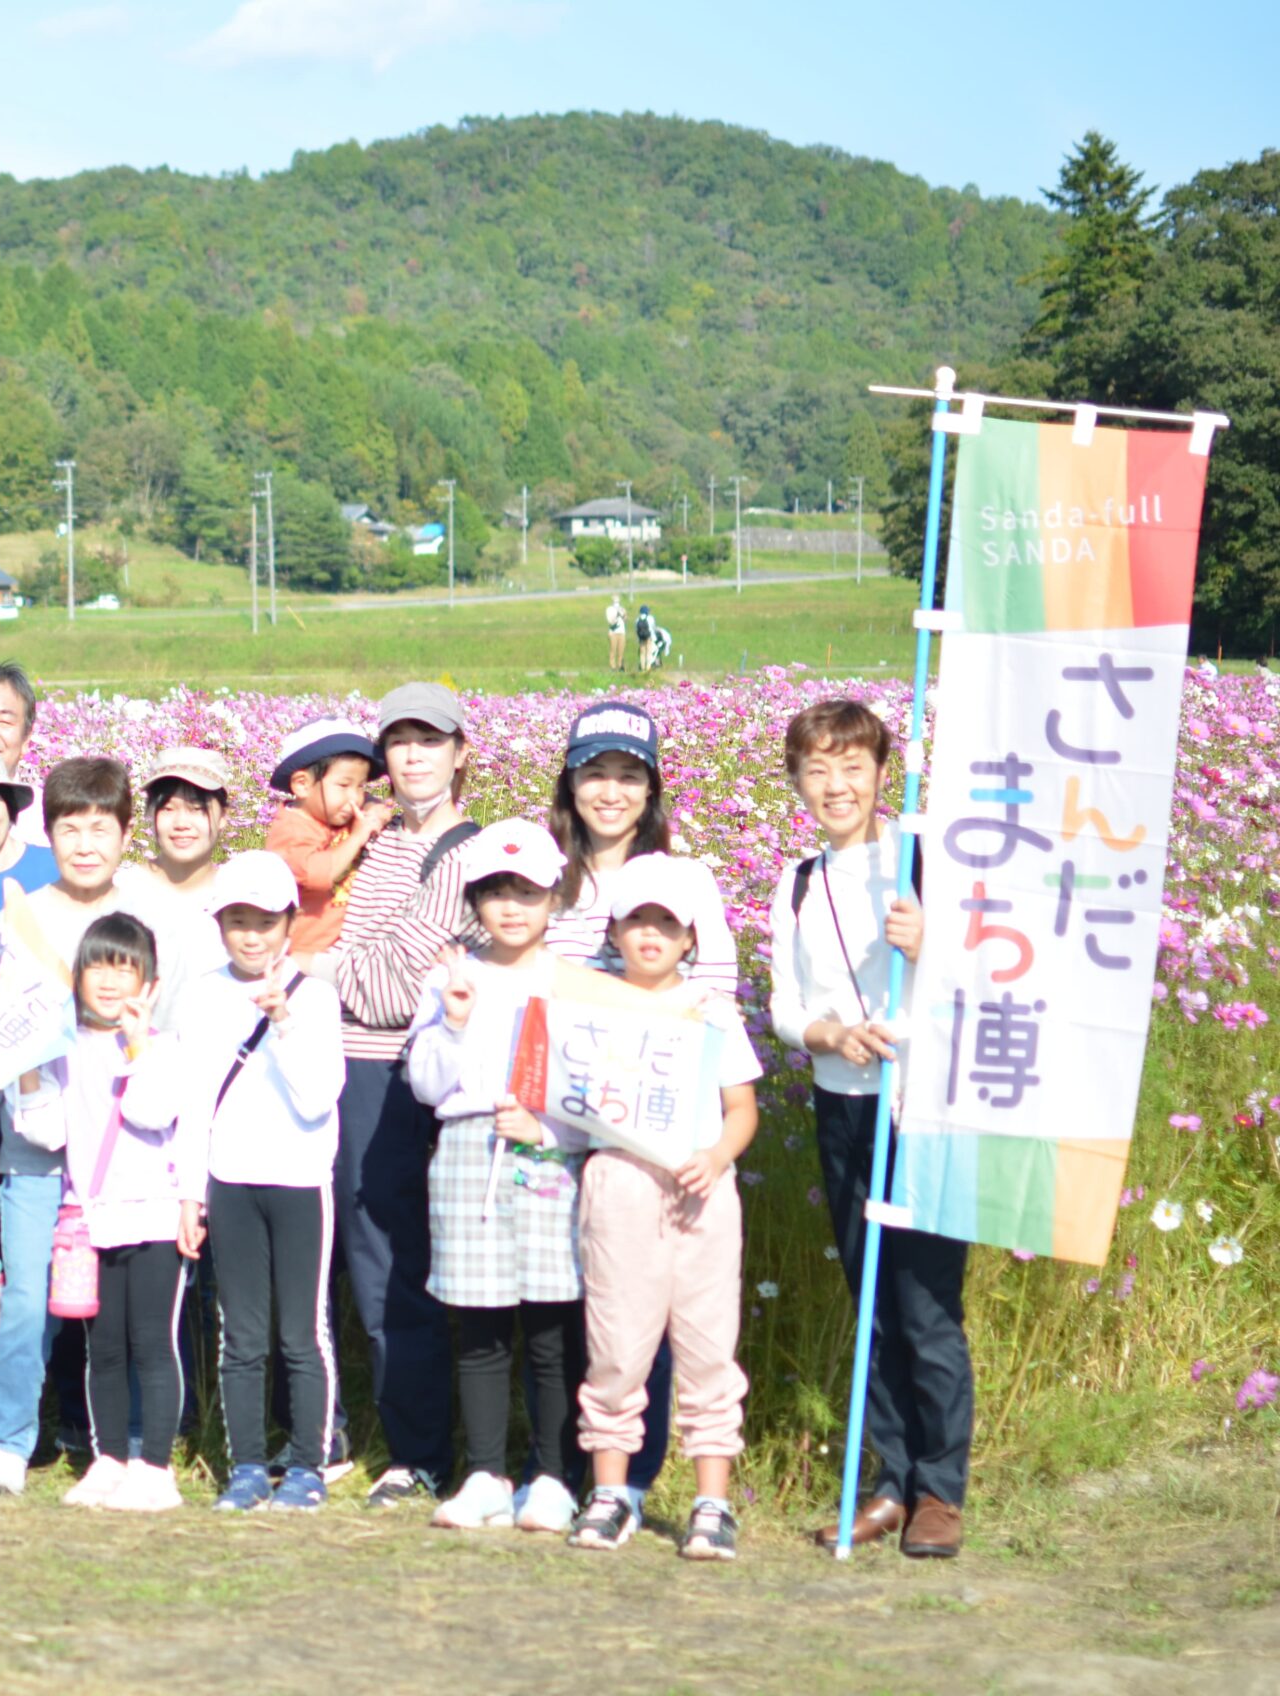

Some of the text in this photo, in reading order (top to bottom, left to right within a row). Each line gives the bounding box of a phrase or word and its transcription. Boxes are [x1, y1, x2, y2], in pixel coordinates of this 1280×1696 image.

[981, 494, 1163, 533] Sanda-full
[982, 538, 1097, 568] SANDA
[1043, 652, 1155, 971] さんだ
[931, 752, 1054, 1109] まち博
